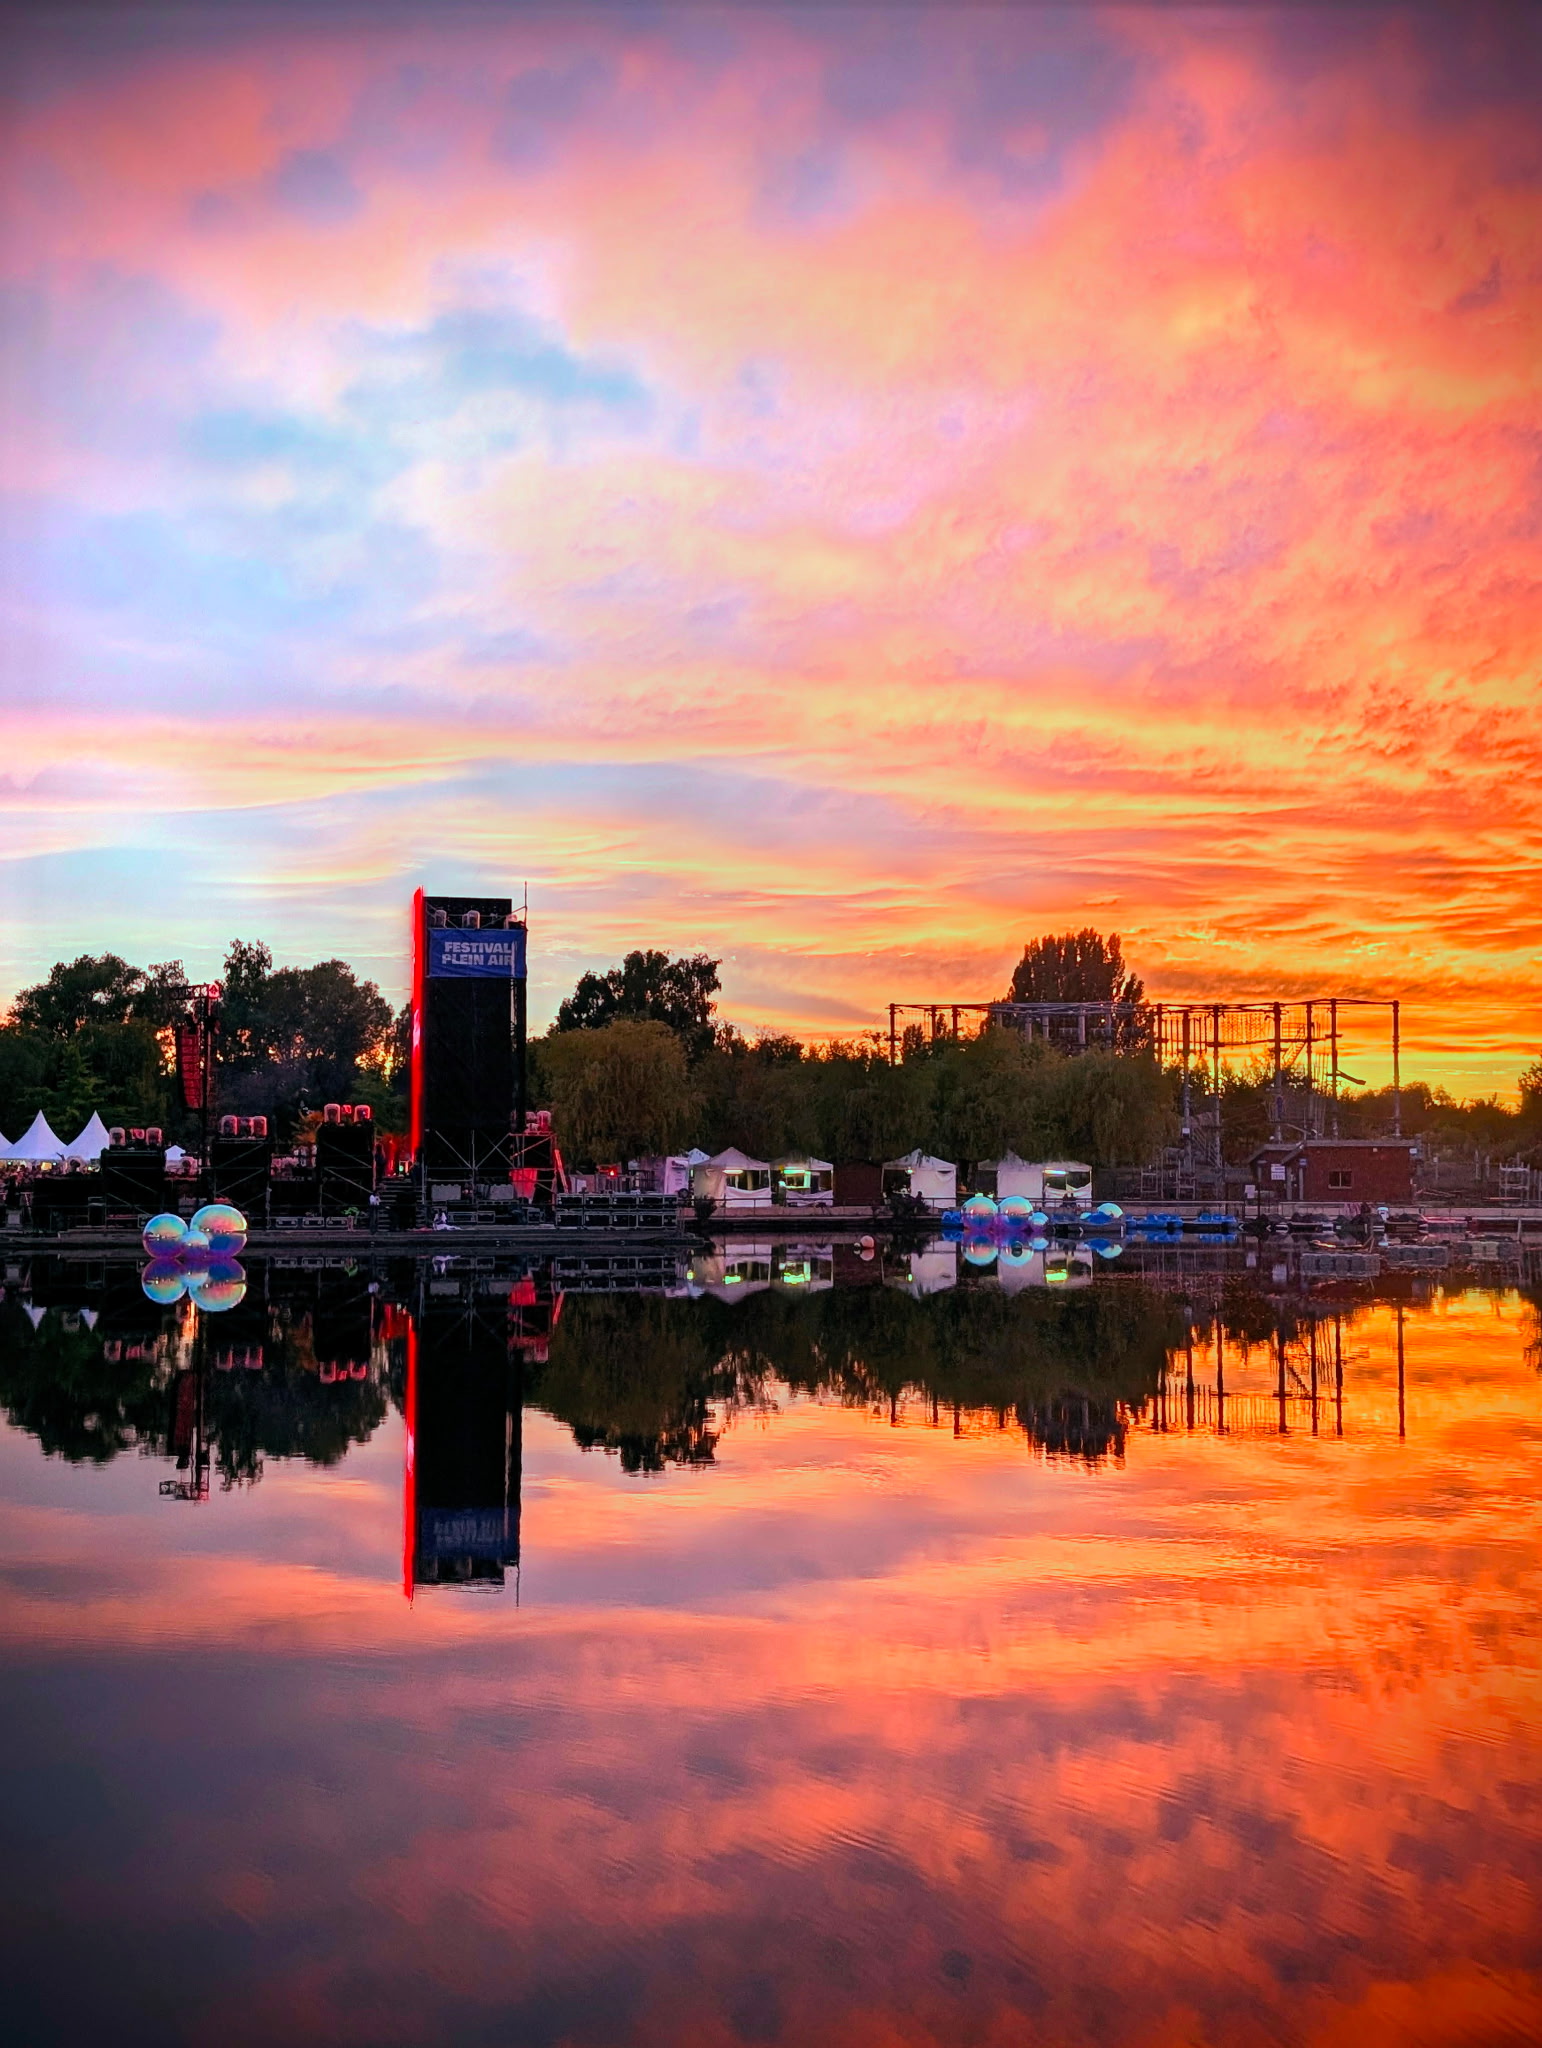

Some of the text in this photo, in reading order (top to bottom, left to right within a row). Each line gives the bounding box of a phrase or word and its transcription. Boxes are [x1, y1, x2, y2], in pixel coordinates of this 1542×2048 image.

[444, 941, 512, 954] FESTIVAL
[441, 954, 513, 966] PLEIN AIR
